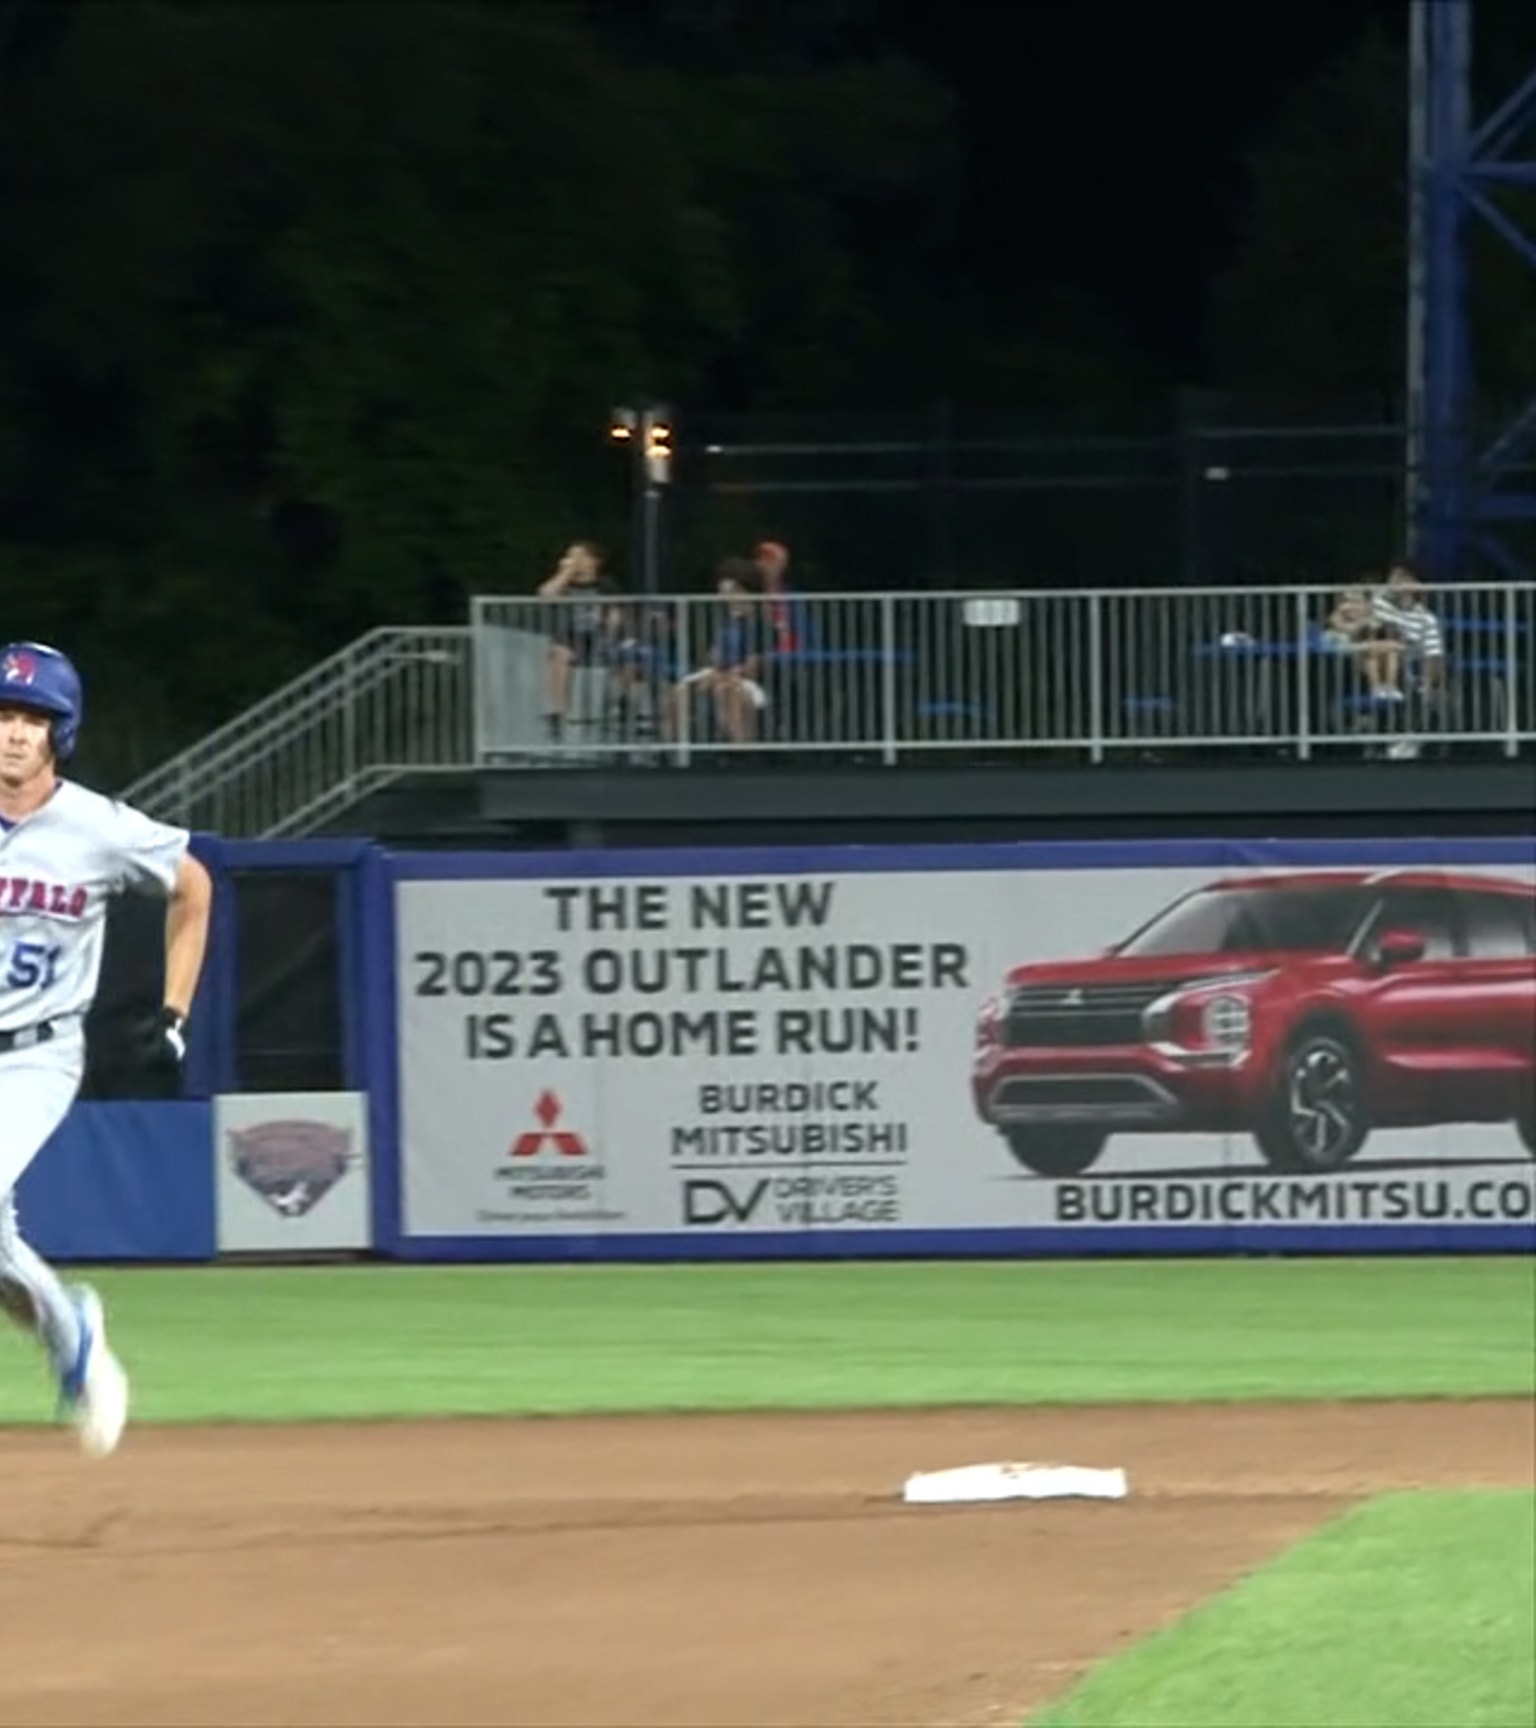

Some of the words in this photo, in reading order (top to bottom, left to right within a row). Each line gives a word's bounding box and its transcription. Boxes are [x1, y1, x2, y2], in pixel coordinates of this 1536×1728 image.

[544, 884, 667, 932] THE
[690, 881, 836, 930] NEW
[7, 941, 61, 991] 51
[414, 949, 562, 997] 2023
[583, 942, 971, 995] OUTLANDER
[465, 1013, 515, 1060] IS
[527, 1013, 568, 1058] A
[583, 1009, 759, 1057] HOME
[775, 1006, 921, 1055] RUN!
[699, 1080, 880, 1114] BURDICK
[670, 1122, 908, 1156] MITSUBISHI
[682, 1178, 770, 1226] DV
[774, 1199, 900, 1223] VILLAGE
[1055, 1180, 1532, 1222] BURDICKMITSU.CO
